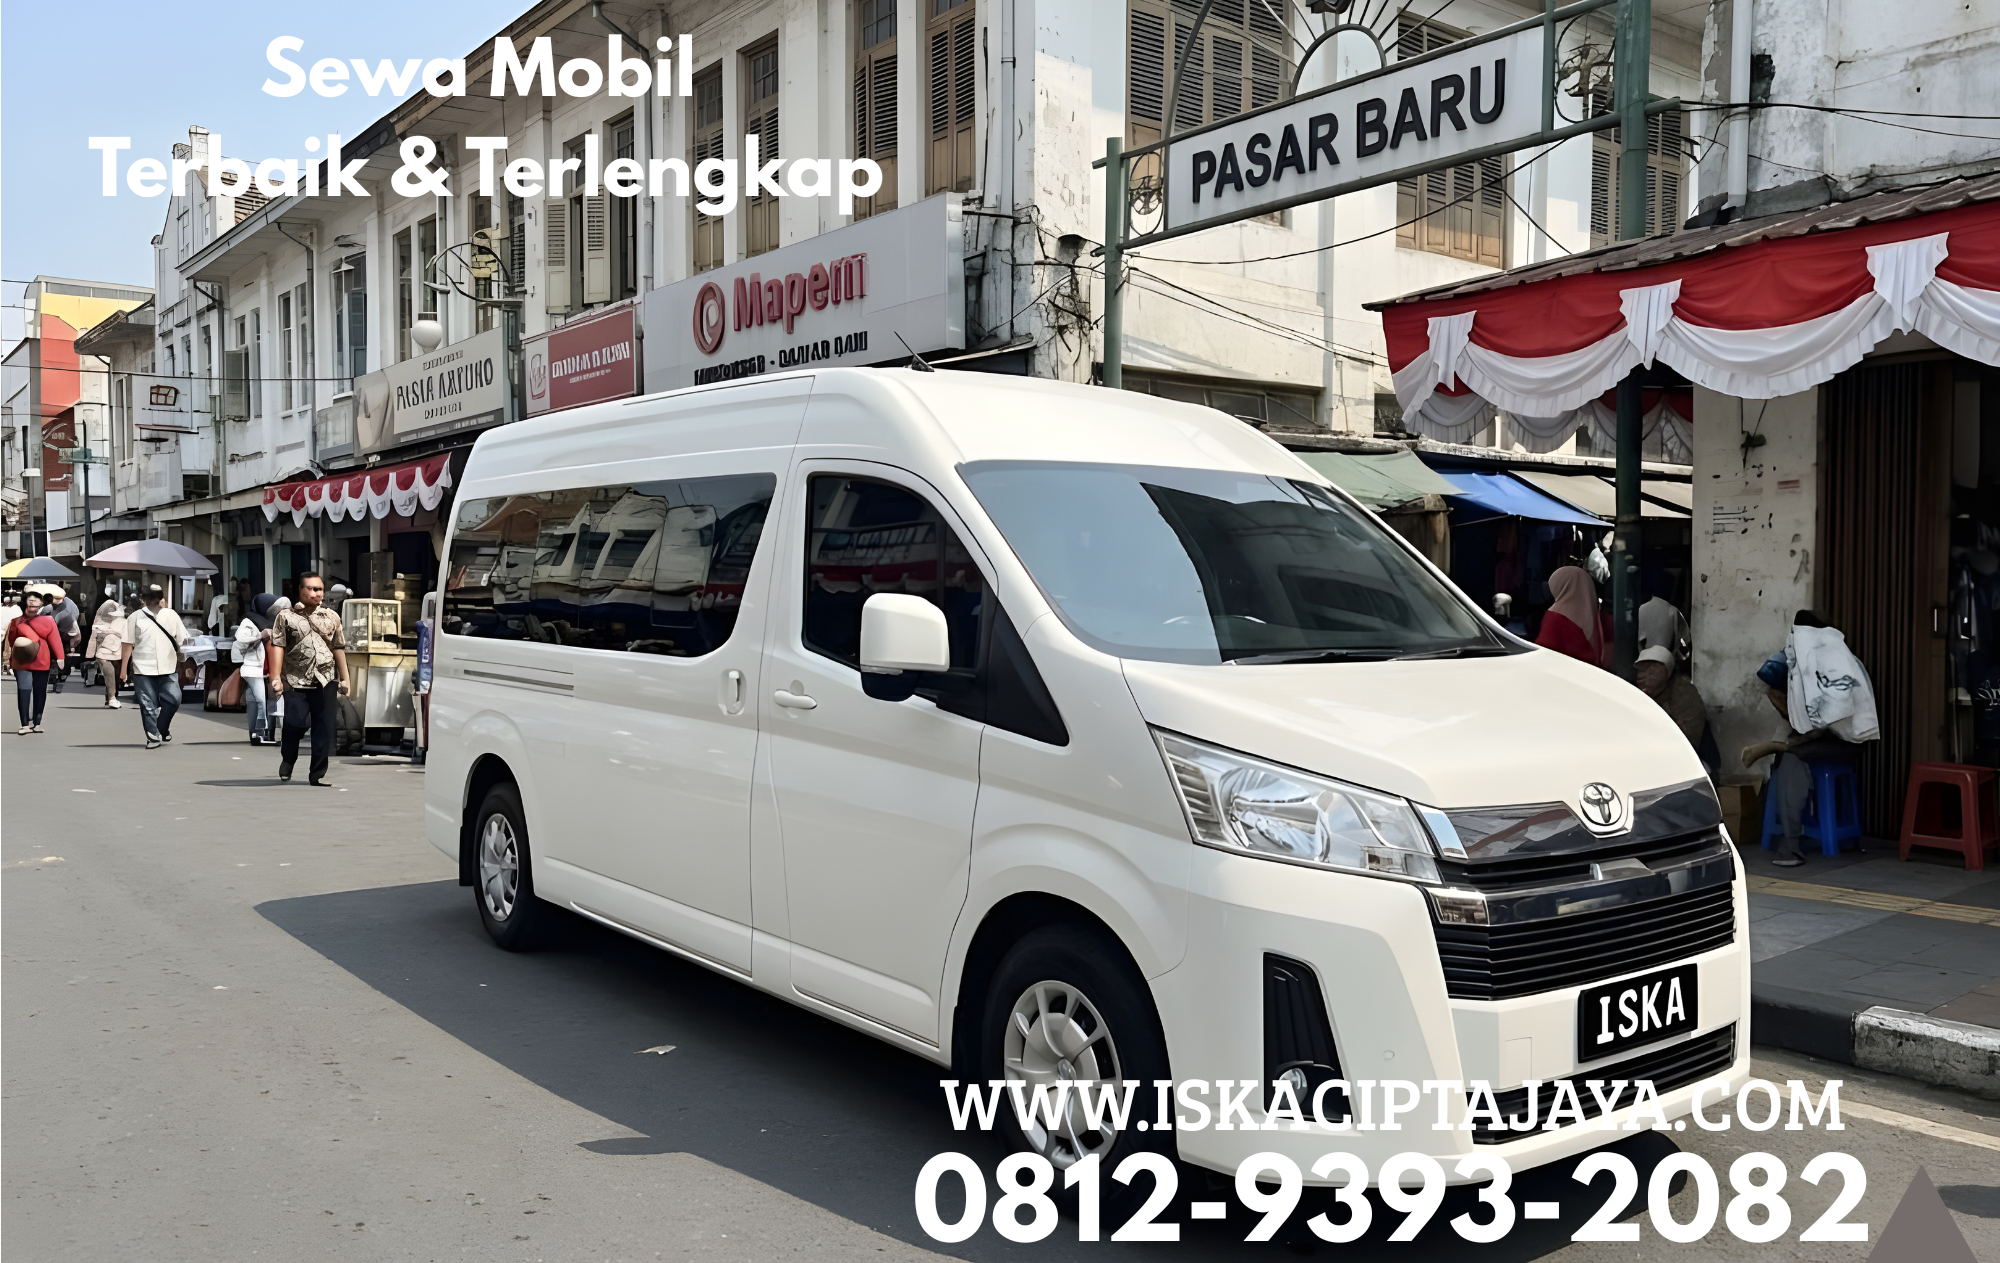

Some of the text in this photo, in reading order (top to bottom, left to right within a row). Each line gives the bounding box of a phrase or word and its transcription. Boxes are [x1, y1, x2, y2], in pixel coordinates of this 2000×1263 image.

[1192, 58, 1506, 205] PASAR BARU
[1596, 976, 1686, 1045] ISKA
